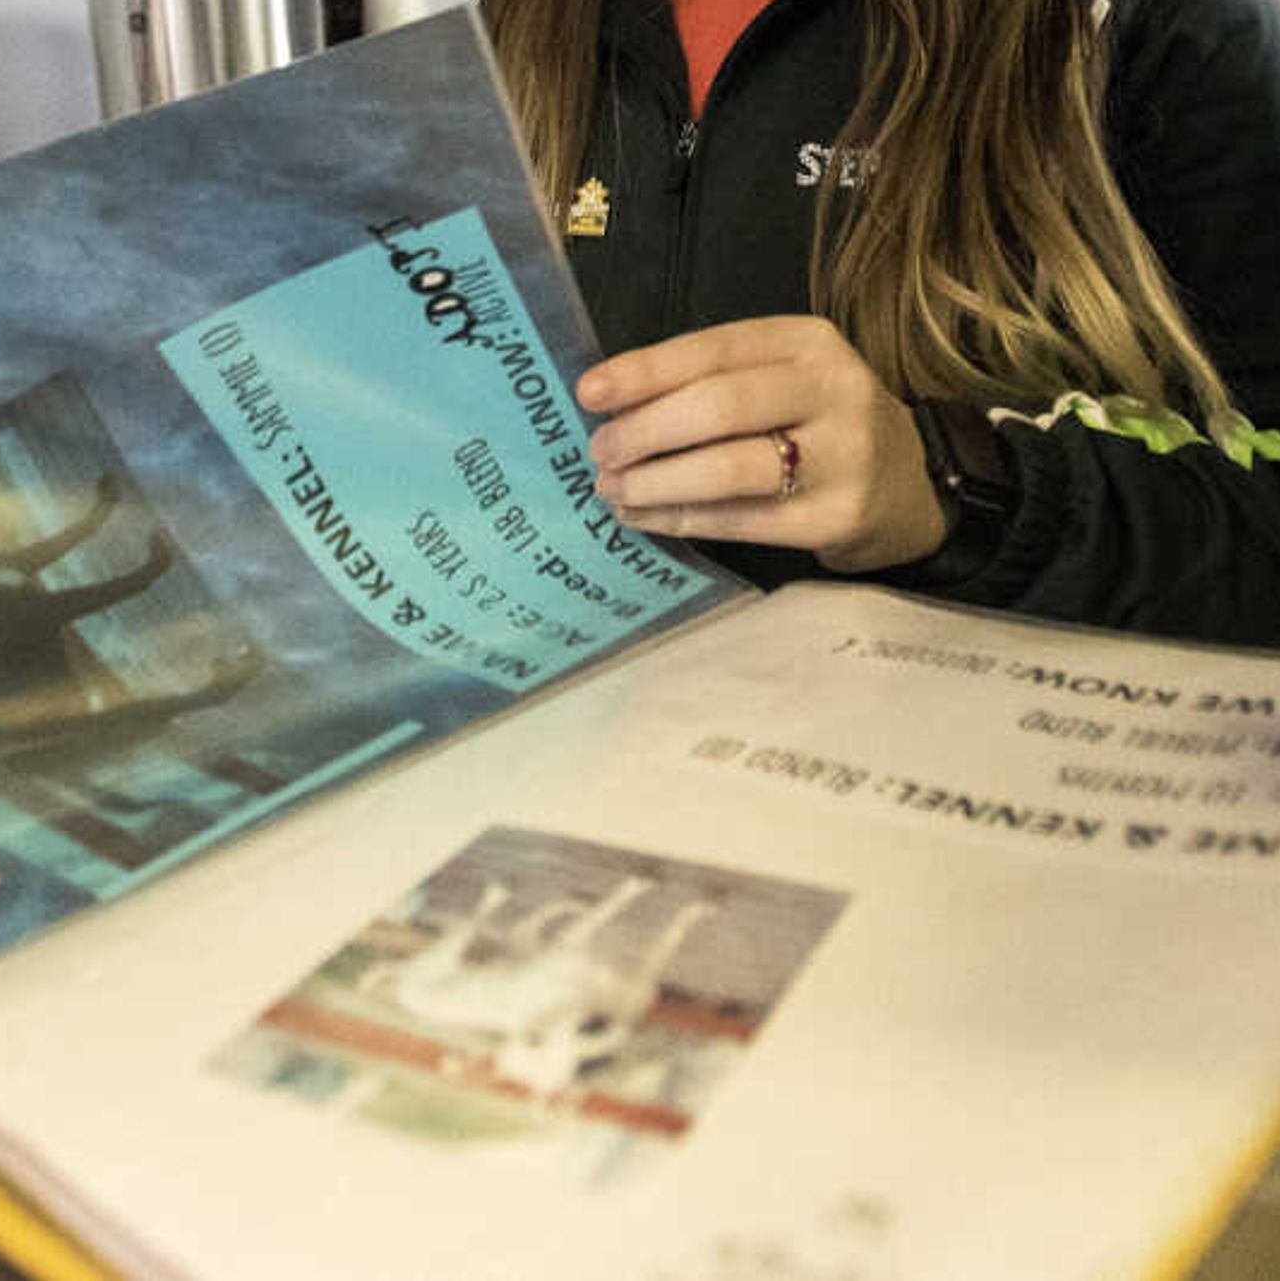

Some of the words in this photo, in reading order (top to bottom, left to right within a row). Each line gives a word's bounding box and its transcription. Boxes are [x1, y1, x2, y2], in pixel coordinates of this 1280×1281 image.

[366, 215, 495, 350] ADOPT
[218, 353, 294, 451] SAMMIE
[494, 327, 570, 447] KNOW:
[454, 438, 511, 510] BLEND
[549, 445, 596, 511] WE
[281, 444, 395, 601] KENNEL:
[405, 510, 470, 581] YEARS
[493, 505, 541, 553] LAB
[583, 511, 691, 592] WHAT
[391, 596, 427, 627] &
[1004, 662, 1182, 707] KNOW:
[1192, 694, 1276, 717] WE
[873, 774, 1105, 841] KENNEL:
[1125, 822, 1170, 849] &
